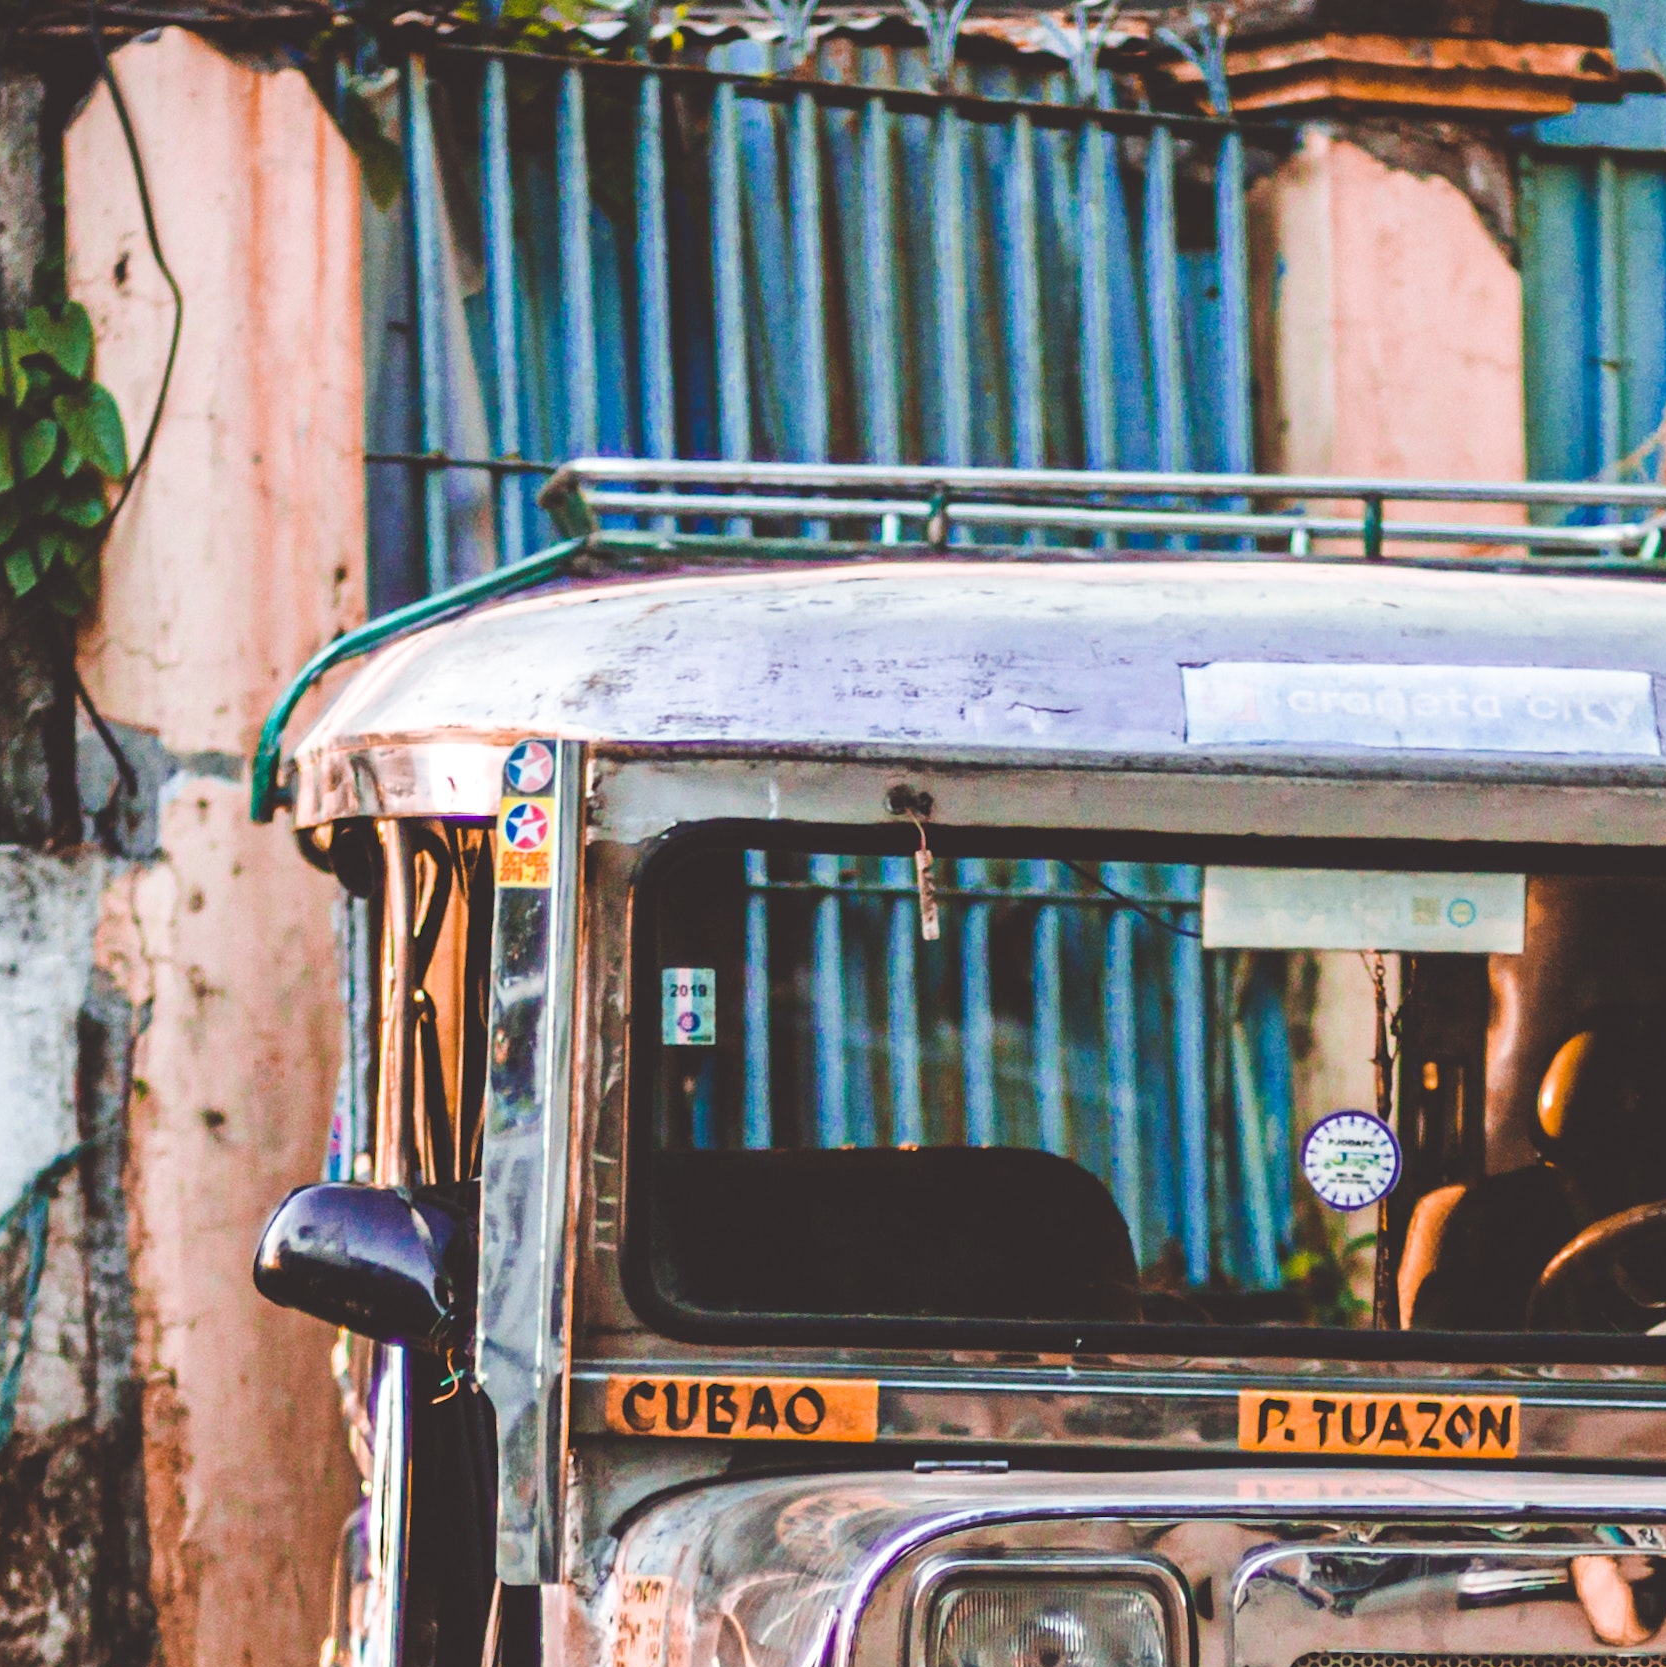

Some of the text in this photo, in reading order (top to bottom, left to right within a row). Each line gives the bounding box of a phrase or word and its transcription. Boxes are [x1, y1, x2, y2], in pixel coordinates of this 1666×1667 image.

[1286, 685, 1639, 732] araneta city
[670, 983, 707, 998] 2019
[622, 1380, 826, 1435] CUBAO
[1312, 1399, 1513, 1450] TUAZON
